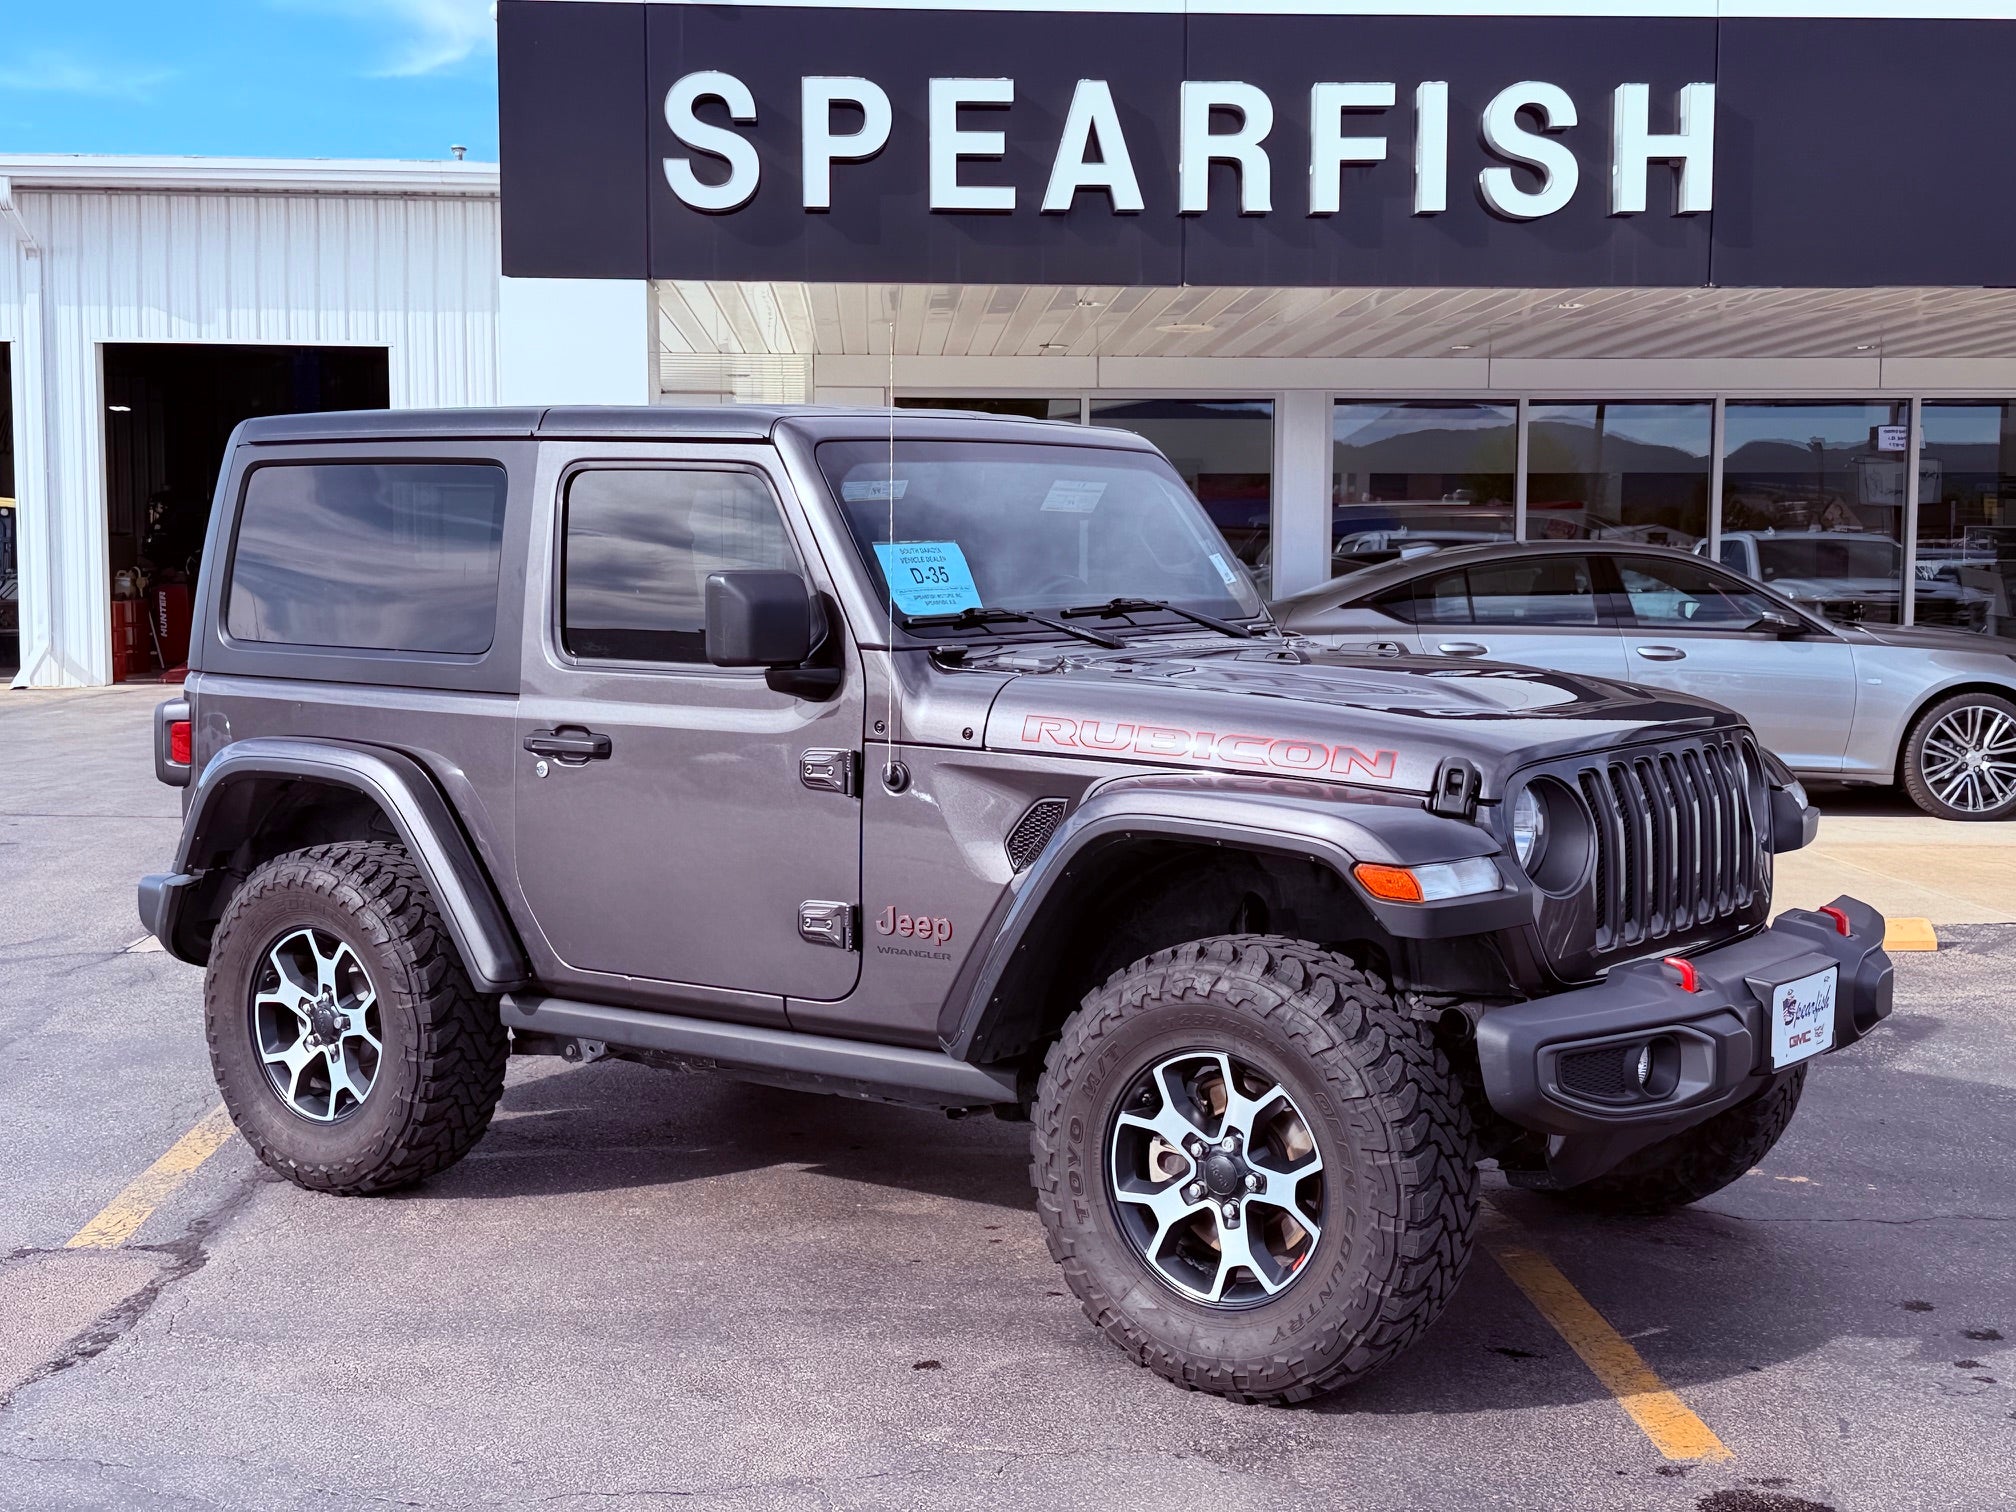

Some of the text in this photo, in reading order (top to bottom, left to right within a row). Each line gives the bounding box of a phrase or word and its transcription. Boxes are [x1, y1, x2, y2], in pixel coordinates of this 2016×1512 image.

[663, 69, 1716, 219] SPEARFISH
[910, 566, 949, 584] D-35
[158, 591, 168, 637] HUNTER
[1021, 714, 1399, 779] RUBICON
[876, 905, 953, 947] Jeep
[877, 945, 951, 961] WRANGLER
[1783, 984, 1832, 1029] Spearfish
[1789, 1030, 1811, 1048] GMC
[1067, 1040, 1120, 1225] TOYO M/T
[1269, 1205, 1358, 1346] COUNTRY
